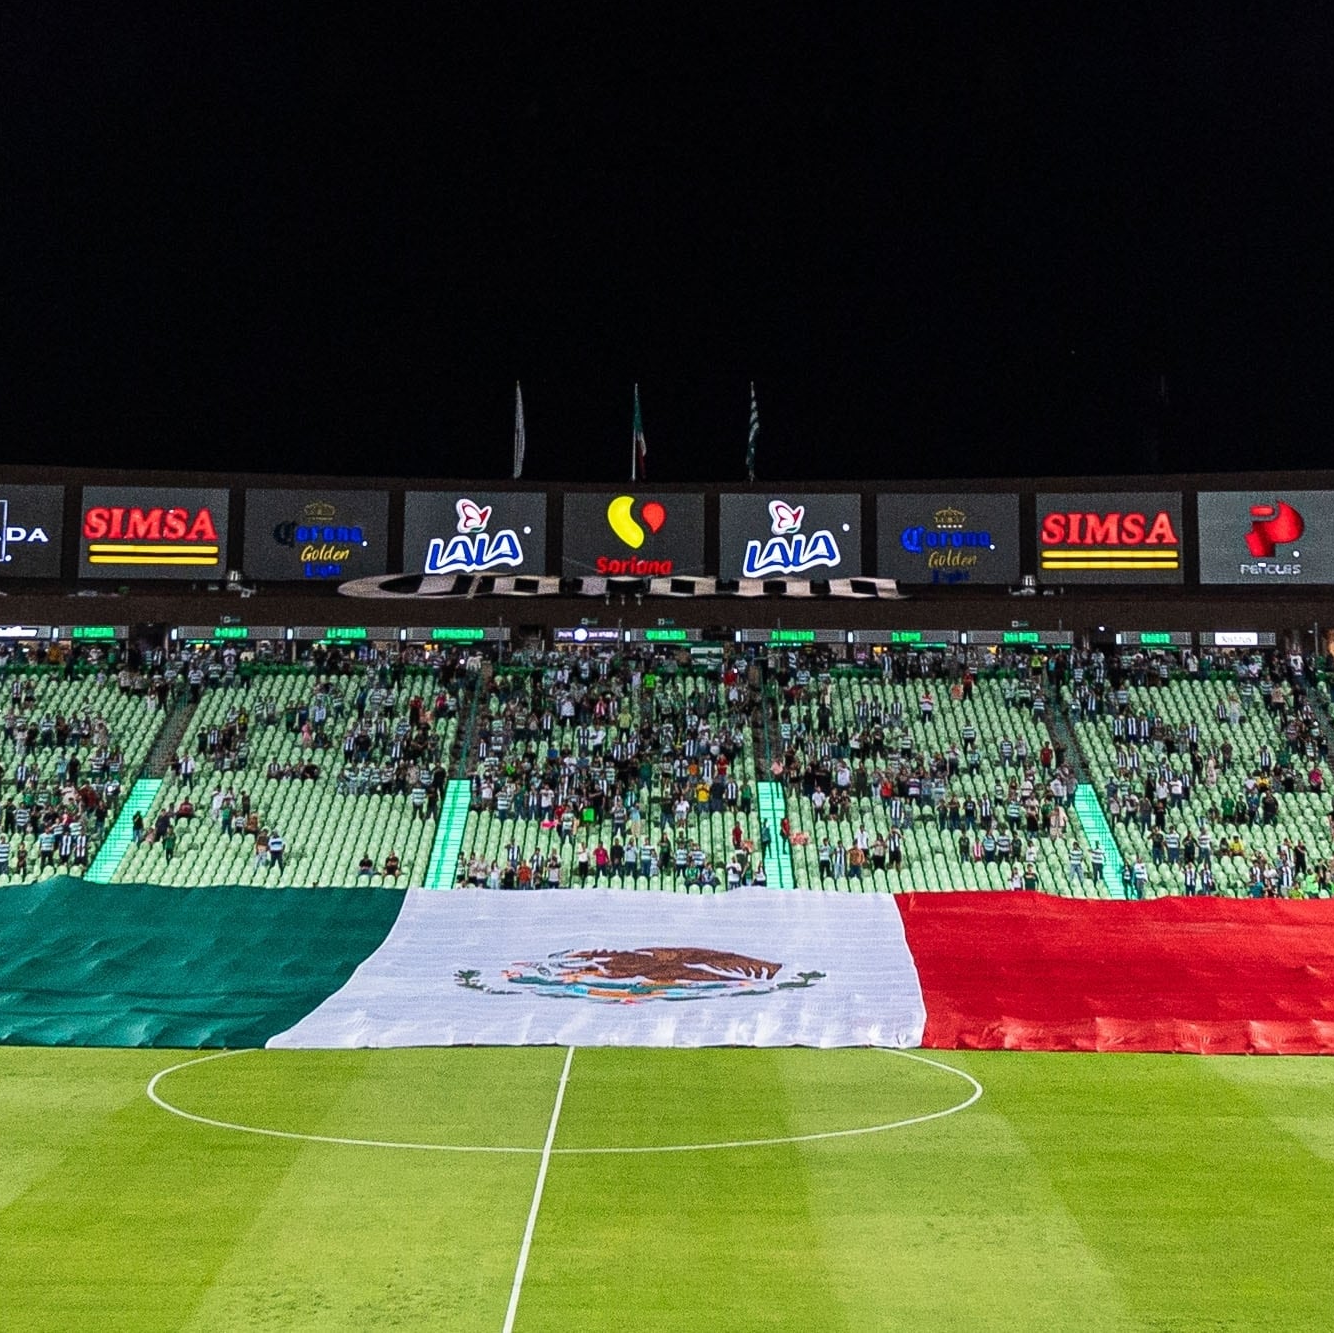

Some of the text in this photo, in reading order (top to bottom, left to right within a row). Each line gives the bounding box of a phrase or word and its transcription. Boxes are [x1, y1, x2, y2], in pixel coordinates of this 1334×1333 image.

[83, 506, 218, 542] SIMSA
[1040, 510, 1179, 546] SIMSA
[300, 544, 351, 563] Golden
[423, 529, 525, 576] LALA
[742, 529, 842, 578] LALA
[900, 526, 991, 555] Corona
[596, 555, 673, 576] Soriana
[928, 549, 978, 568] Golden
